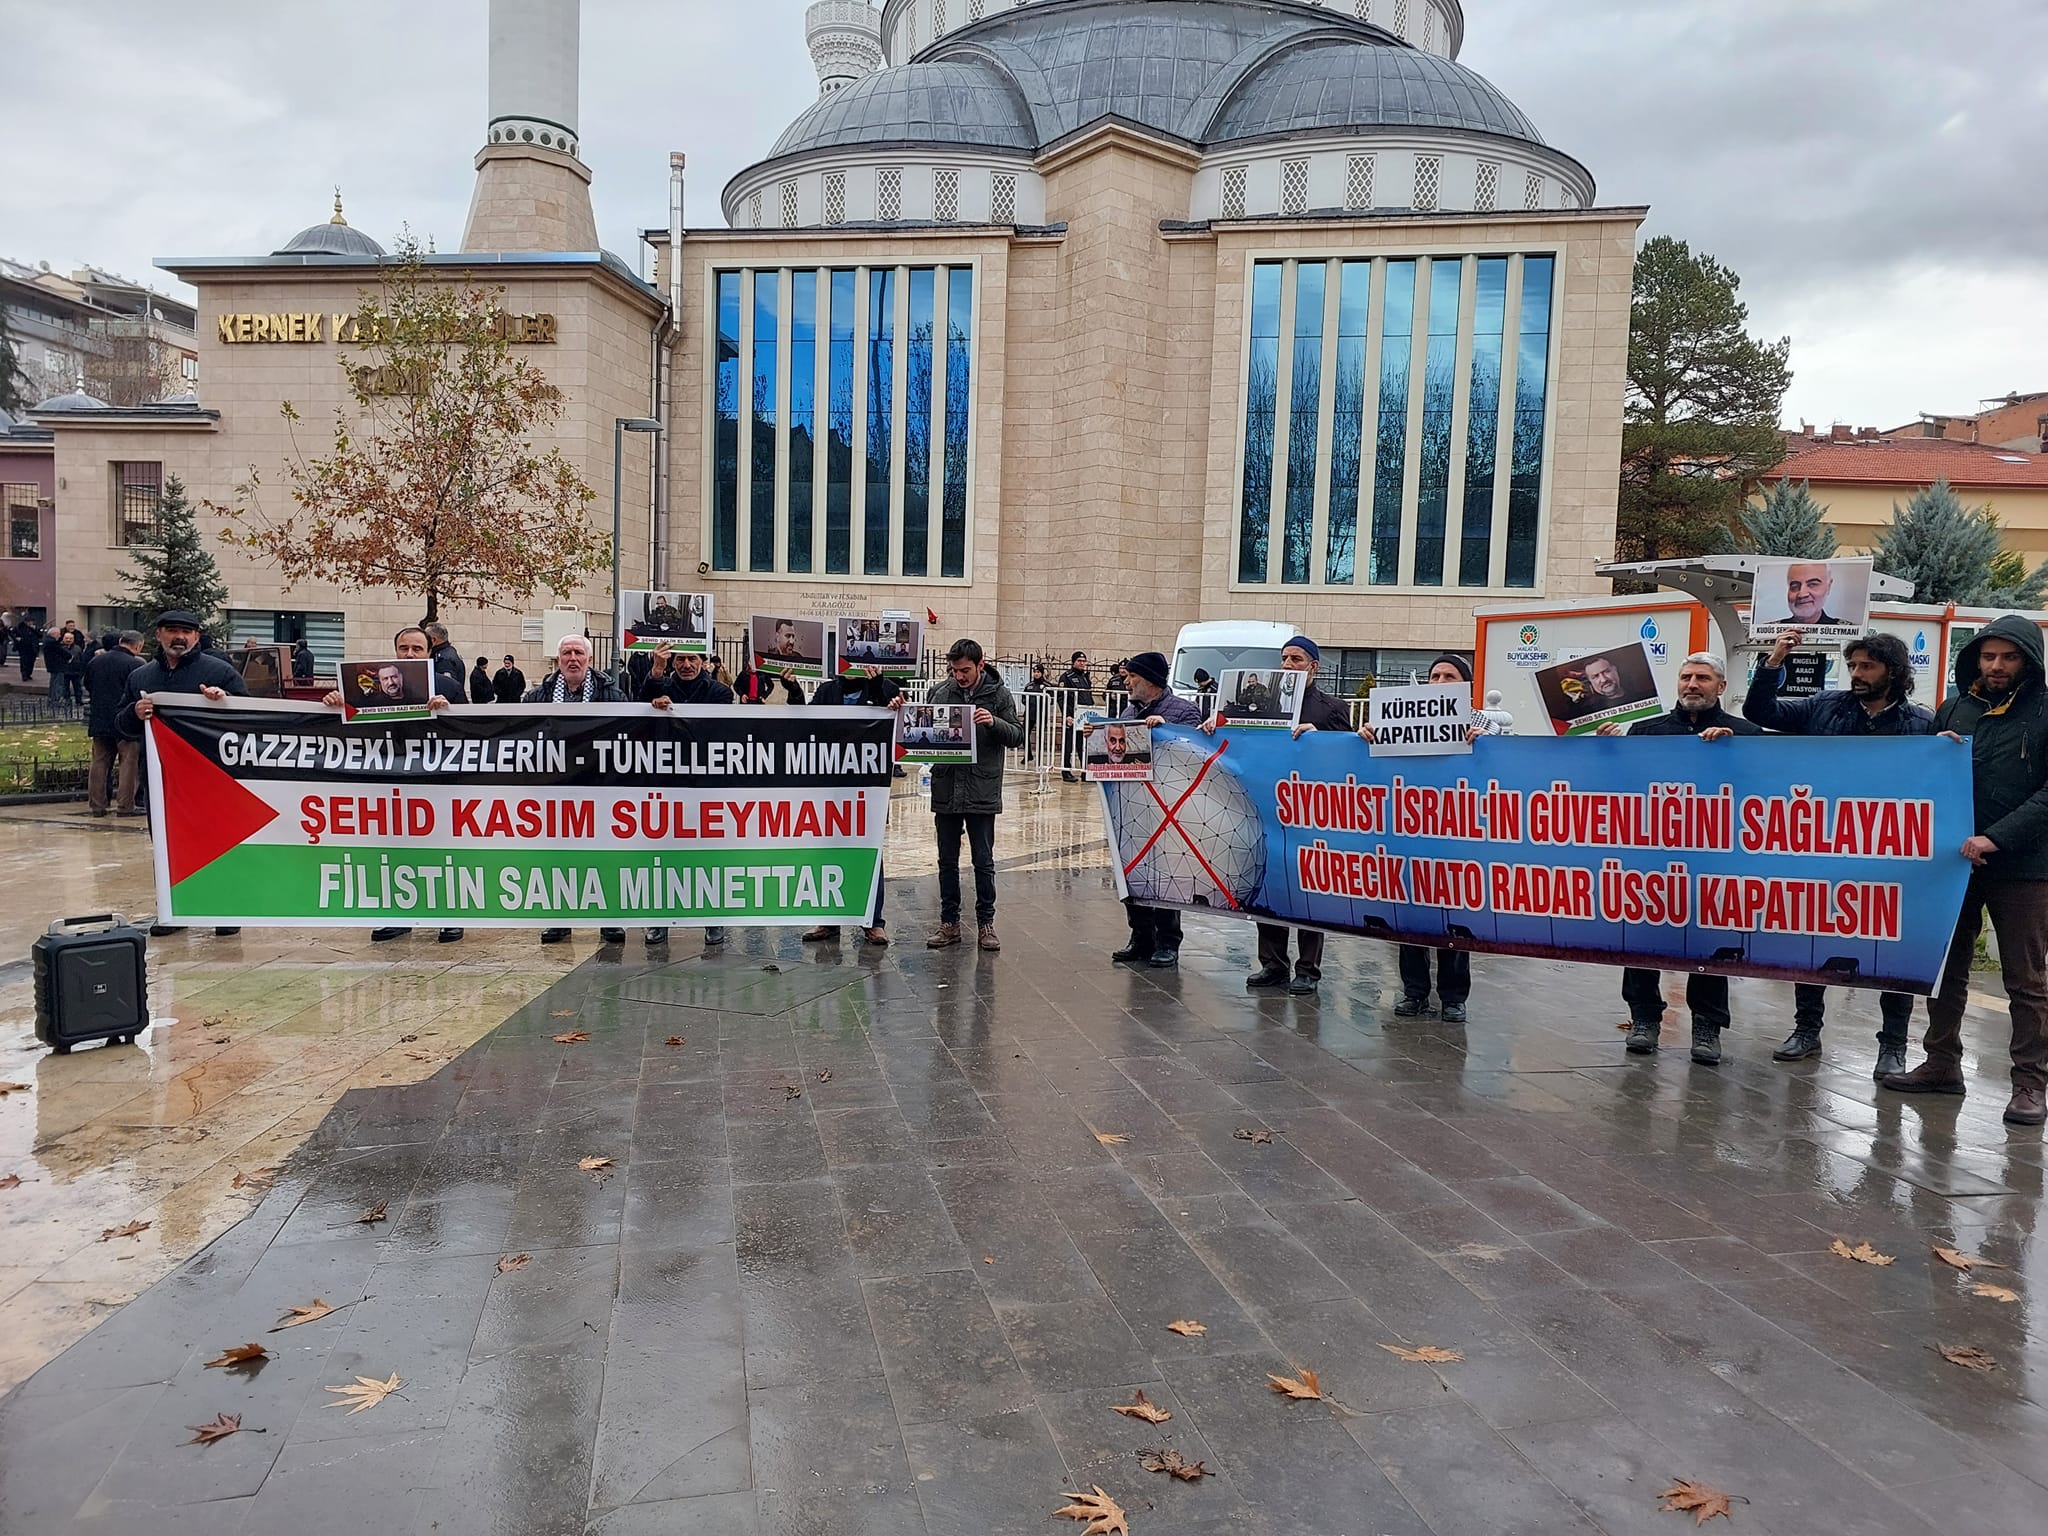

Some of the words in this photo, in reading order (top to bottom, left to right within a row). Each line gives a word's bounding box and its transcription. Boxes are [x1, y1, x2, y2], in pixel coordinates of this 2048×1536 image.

[218, 313, 324, 343] KERNEK
[1820, 626, 1859, 636] SÜLEYMANİ
[1381, 694, 1458, 719] KÜRECİK
[218, 731, 394, 769] GAZZE'DEKİ
[404, 731, 565, 773] FÜZELERİN
[593, 733, 775, 775] TÜNELLERİN
[785, 734, 886, 775] MİMARI
[1369, 723, 1471, 745] KAPATILSIN
[300, 788, 435, 844] ŞEHİD
[452, 799, 595, 838] KASIM
[611, 791, 866, 839] SÜLEYMANİ
[1276, 773, 1387, 832] SİYONİST
[1394, 776, 1520, 841] İSRAİL'İN
[1530, 783, 1730, 849] GÜVENLİĞİNİ
[1742, 787, 1930, 857] SAĞLAYAN
[319, 853, 485, 909] FİLİSTİN
[499, 866, 607, 910] SANA
[619, 857, 845, 909] MİNNETTAR
[1299, 842, 1406, 903] KÜRECİK
[1412, 859, 1483, 909] NATO
[1492, 864, 1593, 917] RADAR
[1602, 861, 1687, 924] ÜSSÜ
[1700, 876, 1898, 938] KAPATILSIN
